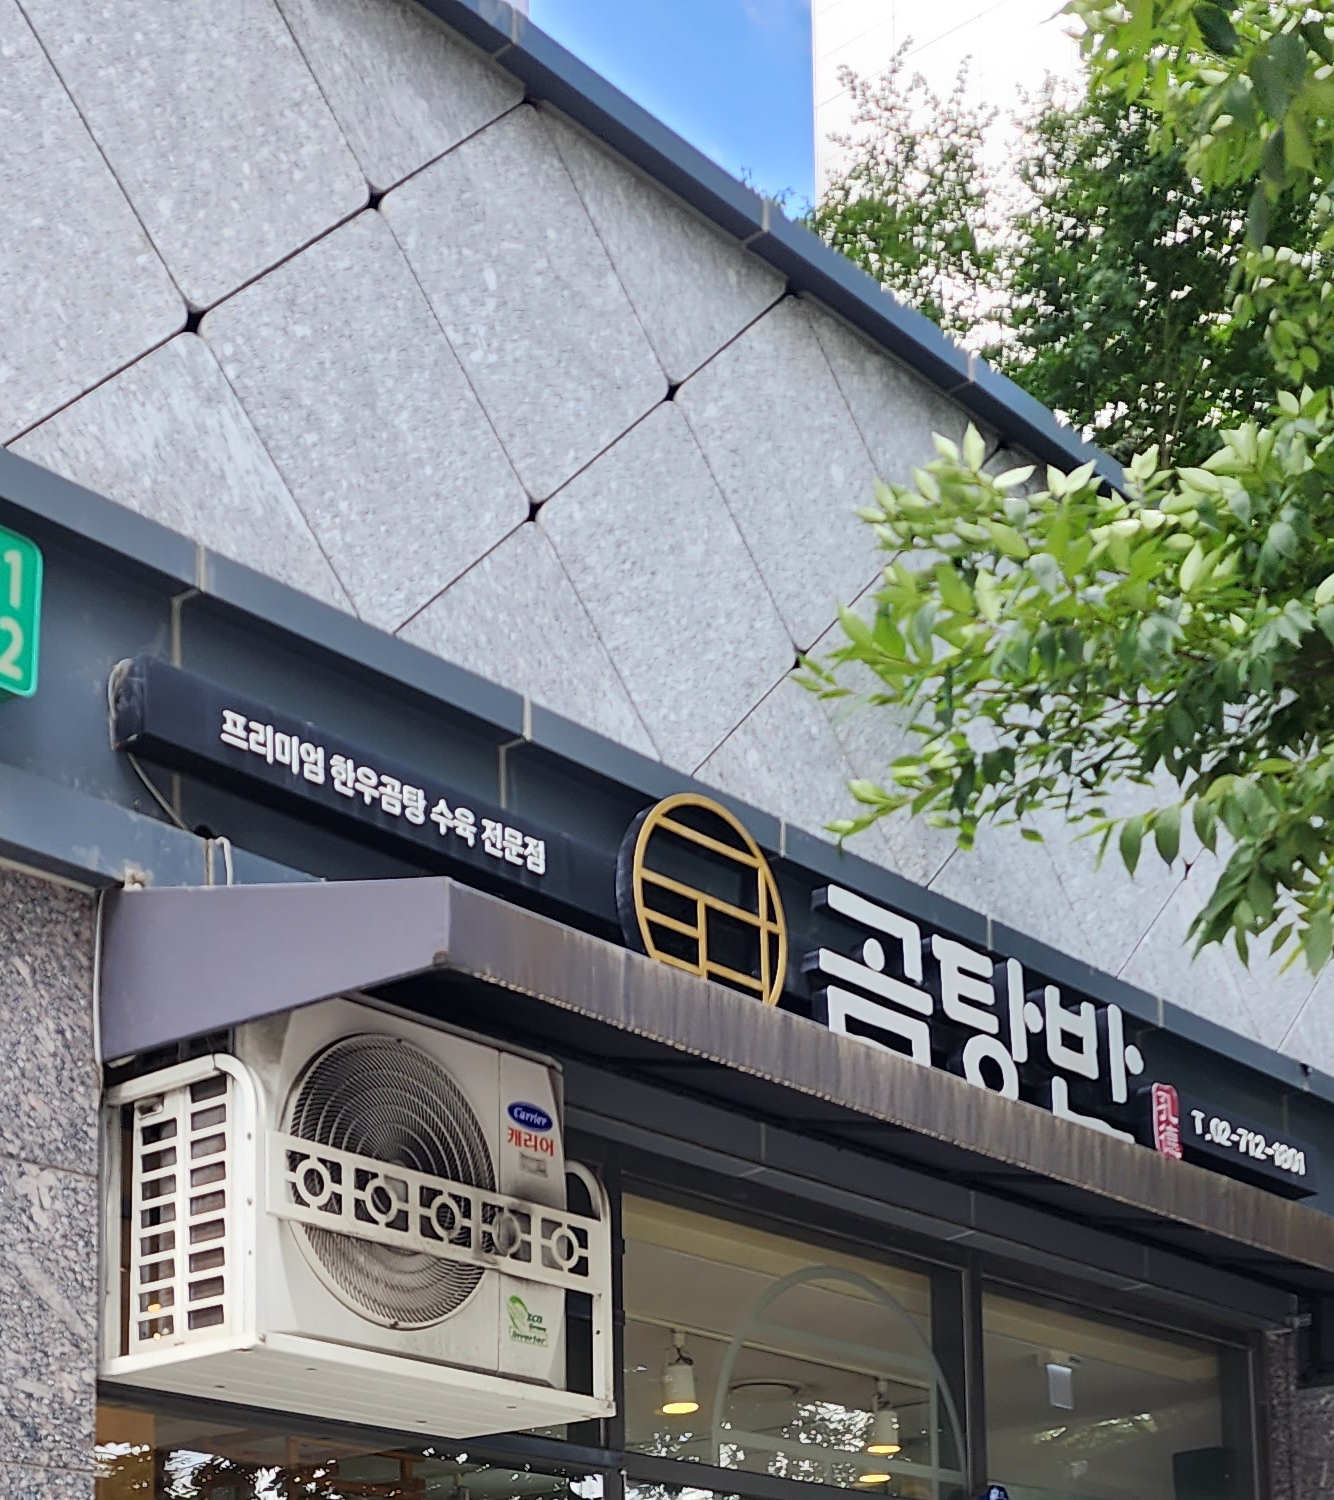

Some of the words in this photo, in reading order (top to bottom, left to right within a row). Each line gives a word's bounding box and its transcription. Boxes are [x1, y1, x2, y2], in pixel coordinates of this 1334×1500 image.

[220, 709, 325, 785] 프리미엄
[329, 754, 427, 827] 한우곰탕
[429, 797, 478, 847] 수육
[481, 817, 547, 875] 전문점
[819, 883, 1145, 1145] 곰탕반
[507, 1126, 554, 1157] 캐리어
[513, 1107, 547, 1126] Carrier
